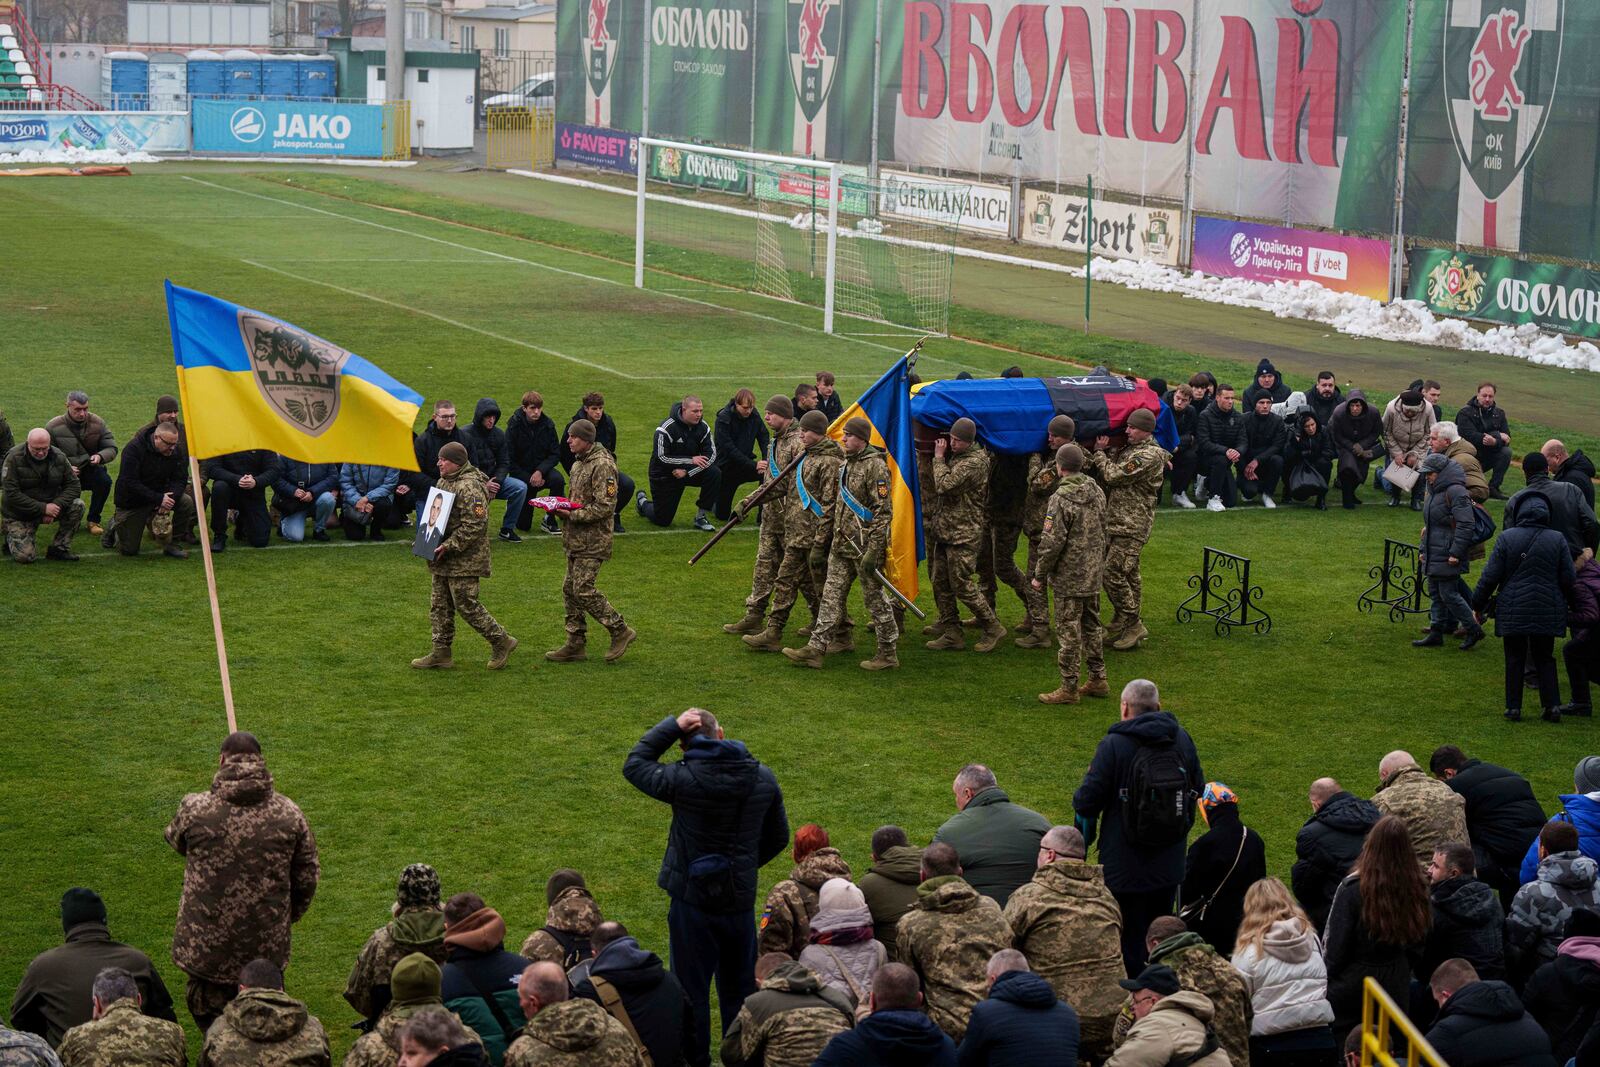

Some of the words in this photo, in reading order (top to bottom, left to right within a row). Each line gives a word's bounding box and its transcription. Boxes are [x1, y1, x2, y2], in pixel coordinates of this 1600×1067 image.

[651, 6, 749, 51] ОБОЛОНЬ
[673, 60, 701, 73] СПОНСОР
[701, 62, 726, 77] ЗАХОДУ
[900, 0, 1341, 168] ВБОЛІВАЙ
[0, 123, 47, 136] РОЗОРА
[273, 113, 351, 140] JAKO
[273, 139, 345, 150] jakosport.com.ua
[573, 131, 627, 158] FAVBET
[988, 140, 1022, 160] ALCOHOL
[1485, 132, 1504, 151] ФК
[686, 154, 739, 182] ОБОЛОНЬ
[1483, 154, 1503, 170] КИЇВ
[899, 182, 1007, 223] GERMANARICH
[1253, 237, 1303, 257] Українська
[1252, 254, 1302, 272] Прем'єр-Ліга
[1322, 257, 1342, 271] vbet
